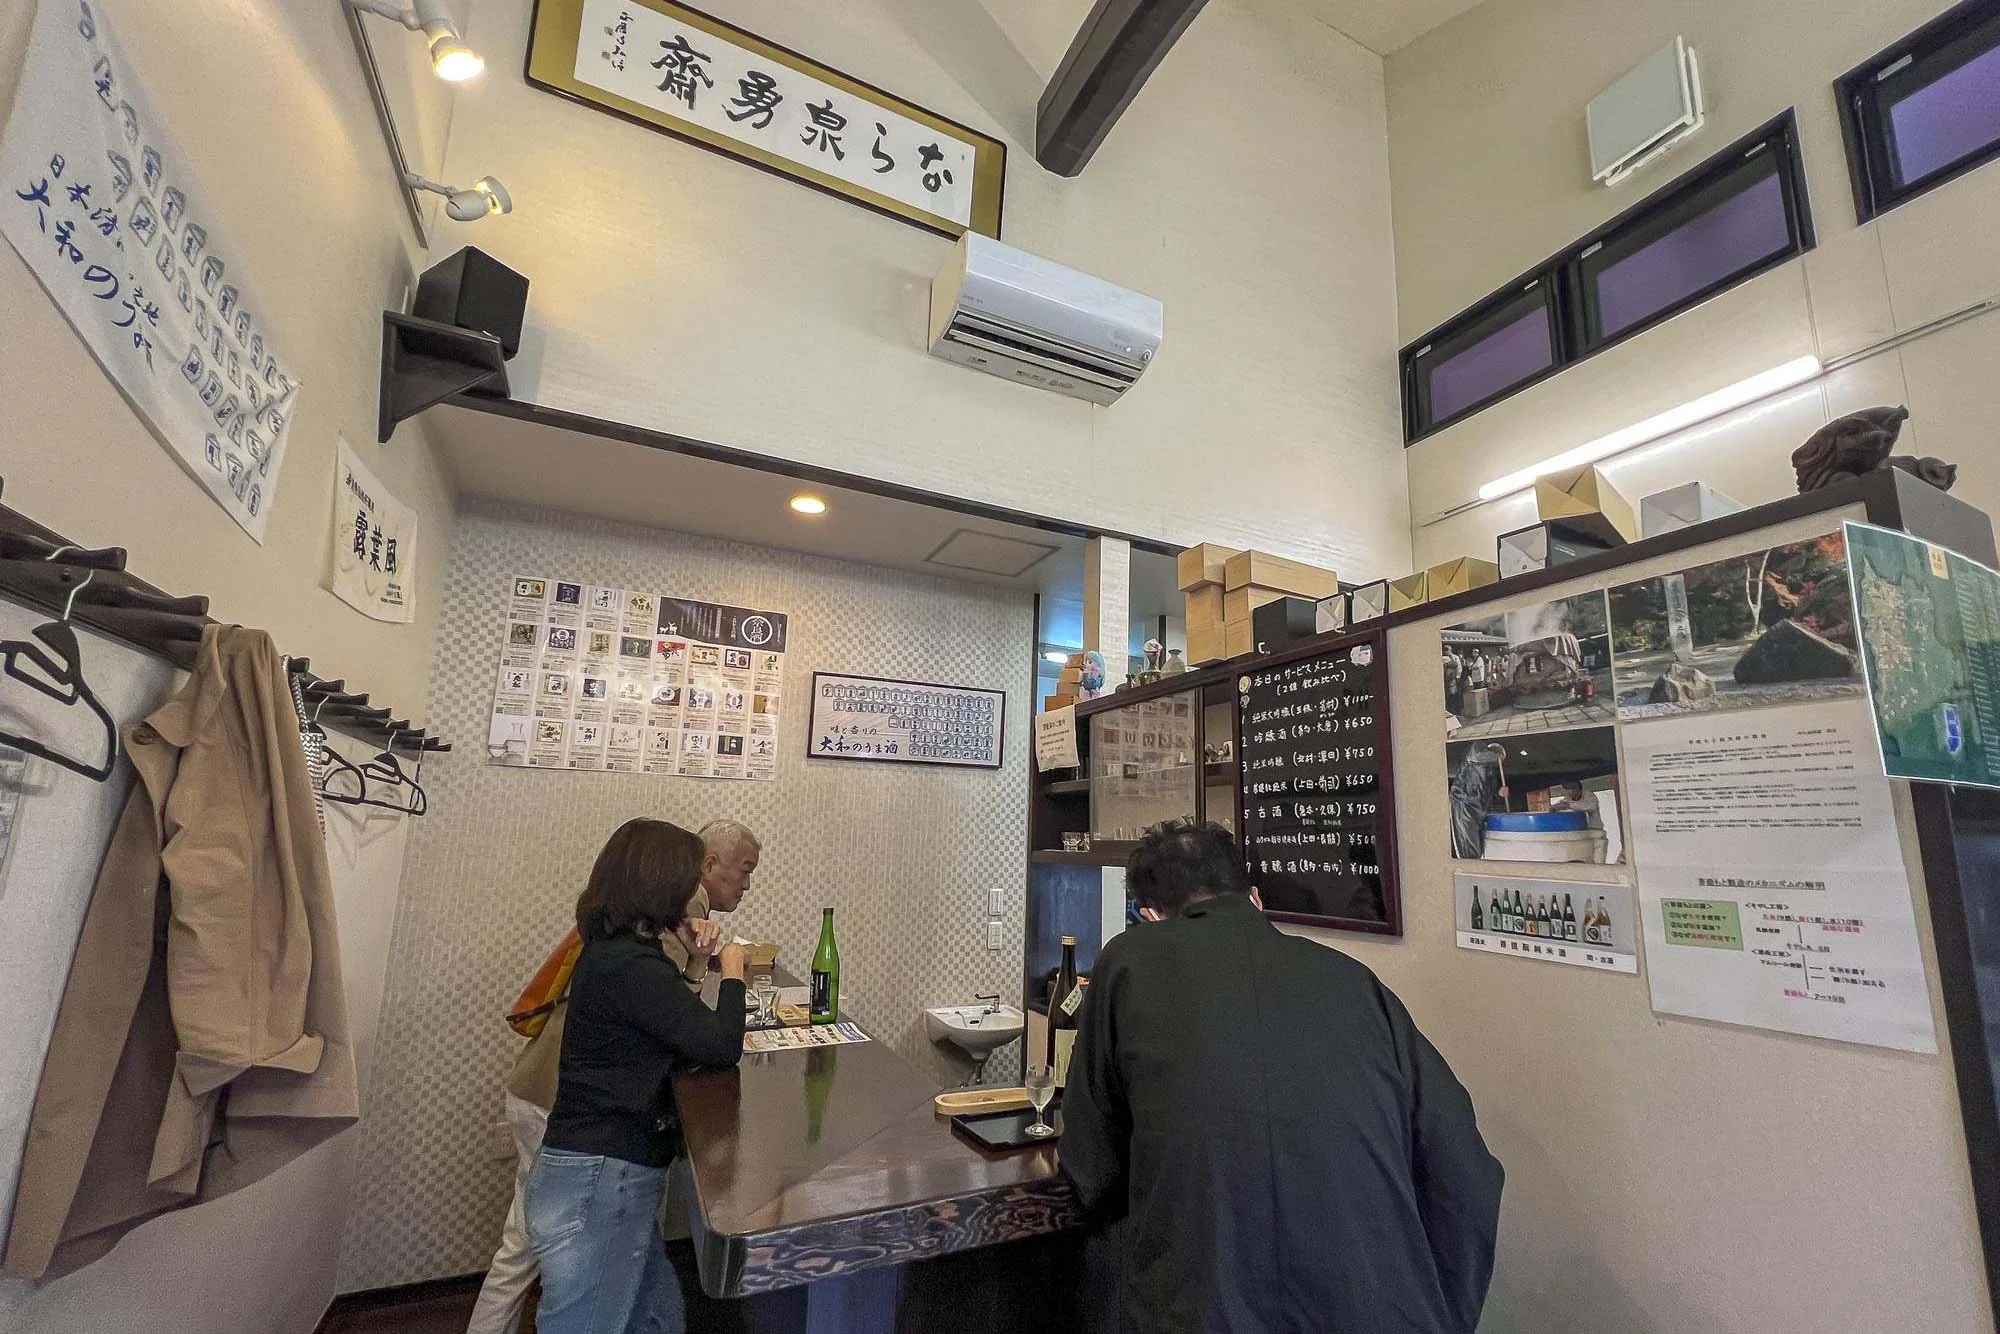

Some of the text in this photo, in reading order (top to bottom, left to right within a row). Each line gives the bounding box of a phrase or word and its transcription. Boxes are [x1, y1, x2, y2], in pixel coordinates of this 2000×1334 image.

[818, 735, 899, 755] 大和のうま酒
